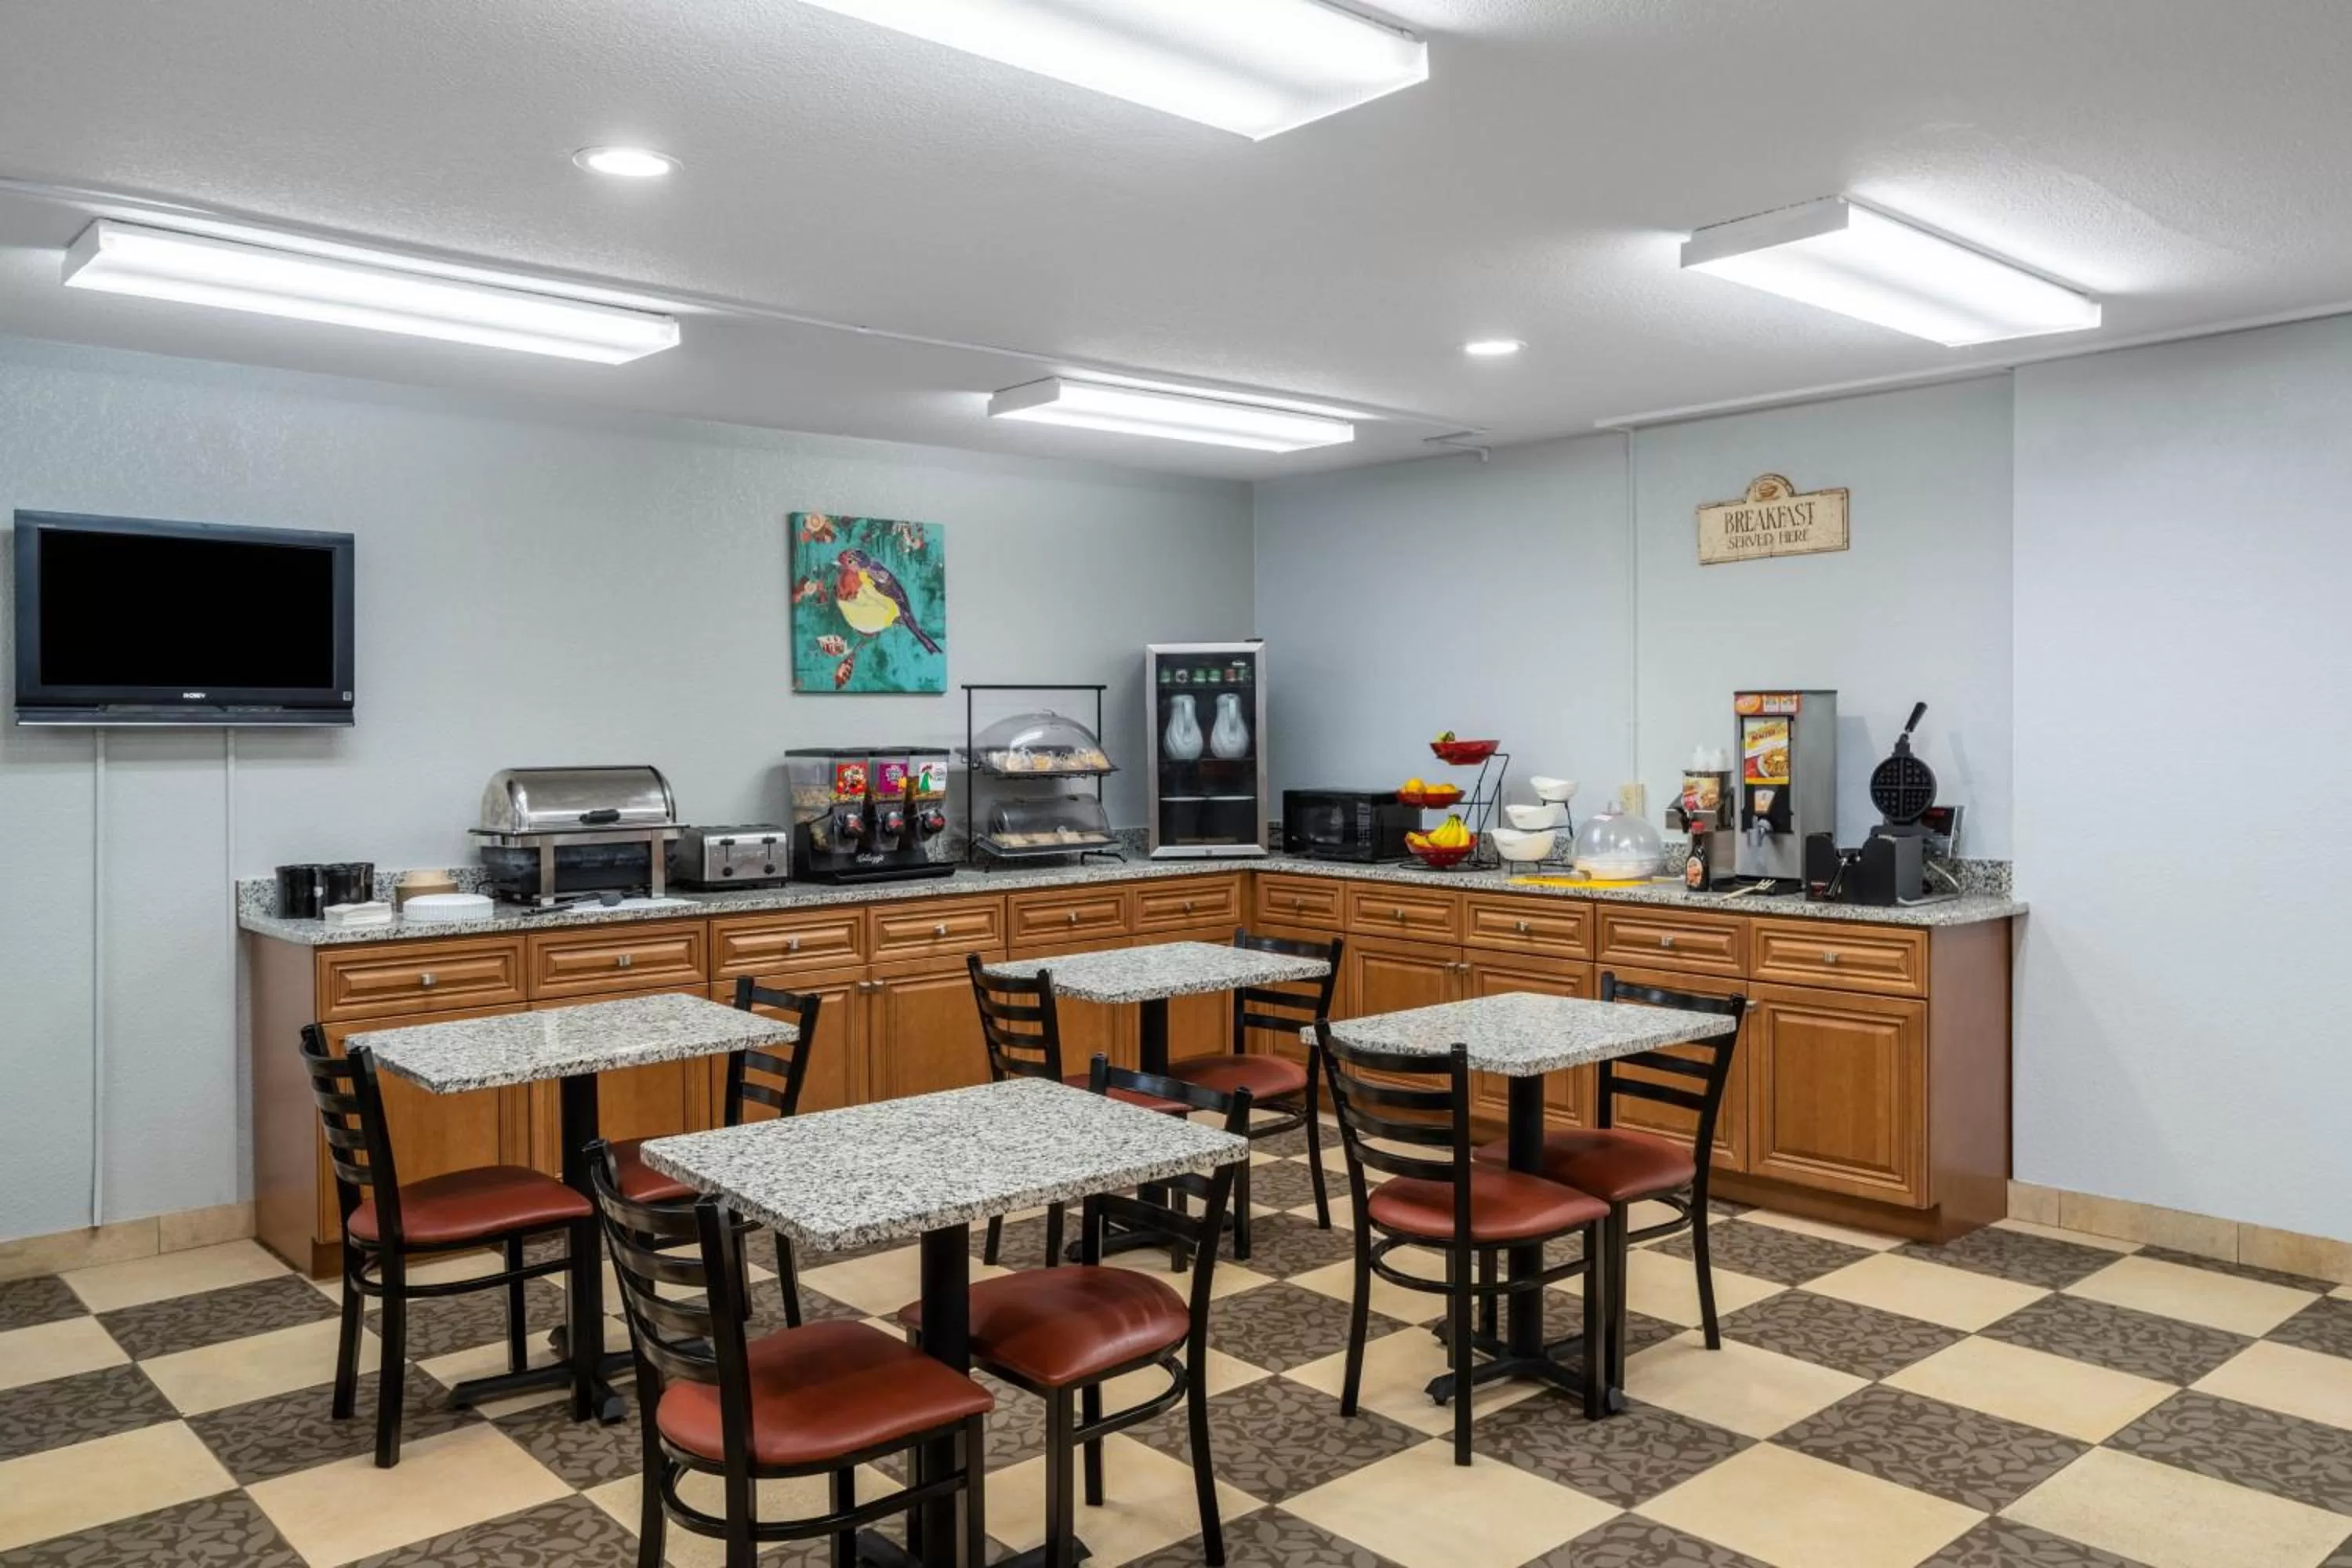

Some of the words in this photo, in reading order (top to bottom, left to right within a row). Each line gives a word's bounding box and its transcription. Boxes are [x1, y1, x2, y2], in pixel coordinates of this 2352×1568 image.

[1725, 502, 1815, 534] BREAKFAST
[1727, 532, 1774, 550] SERVED
[1778, 528, 1809, 545] HERE
